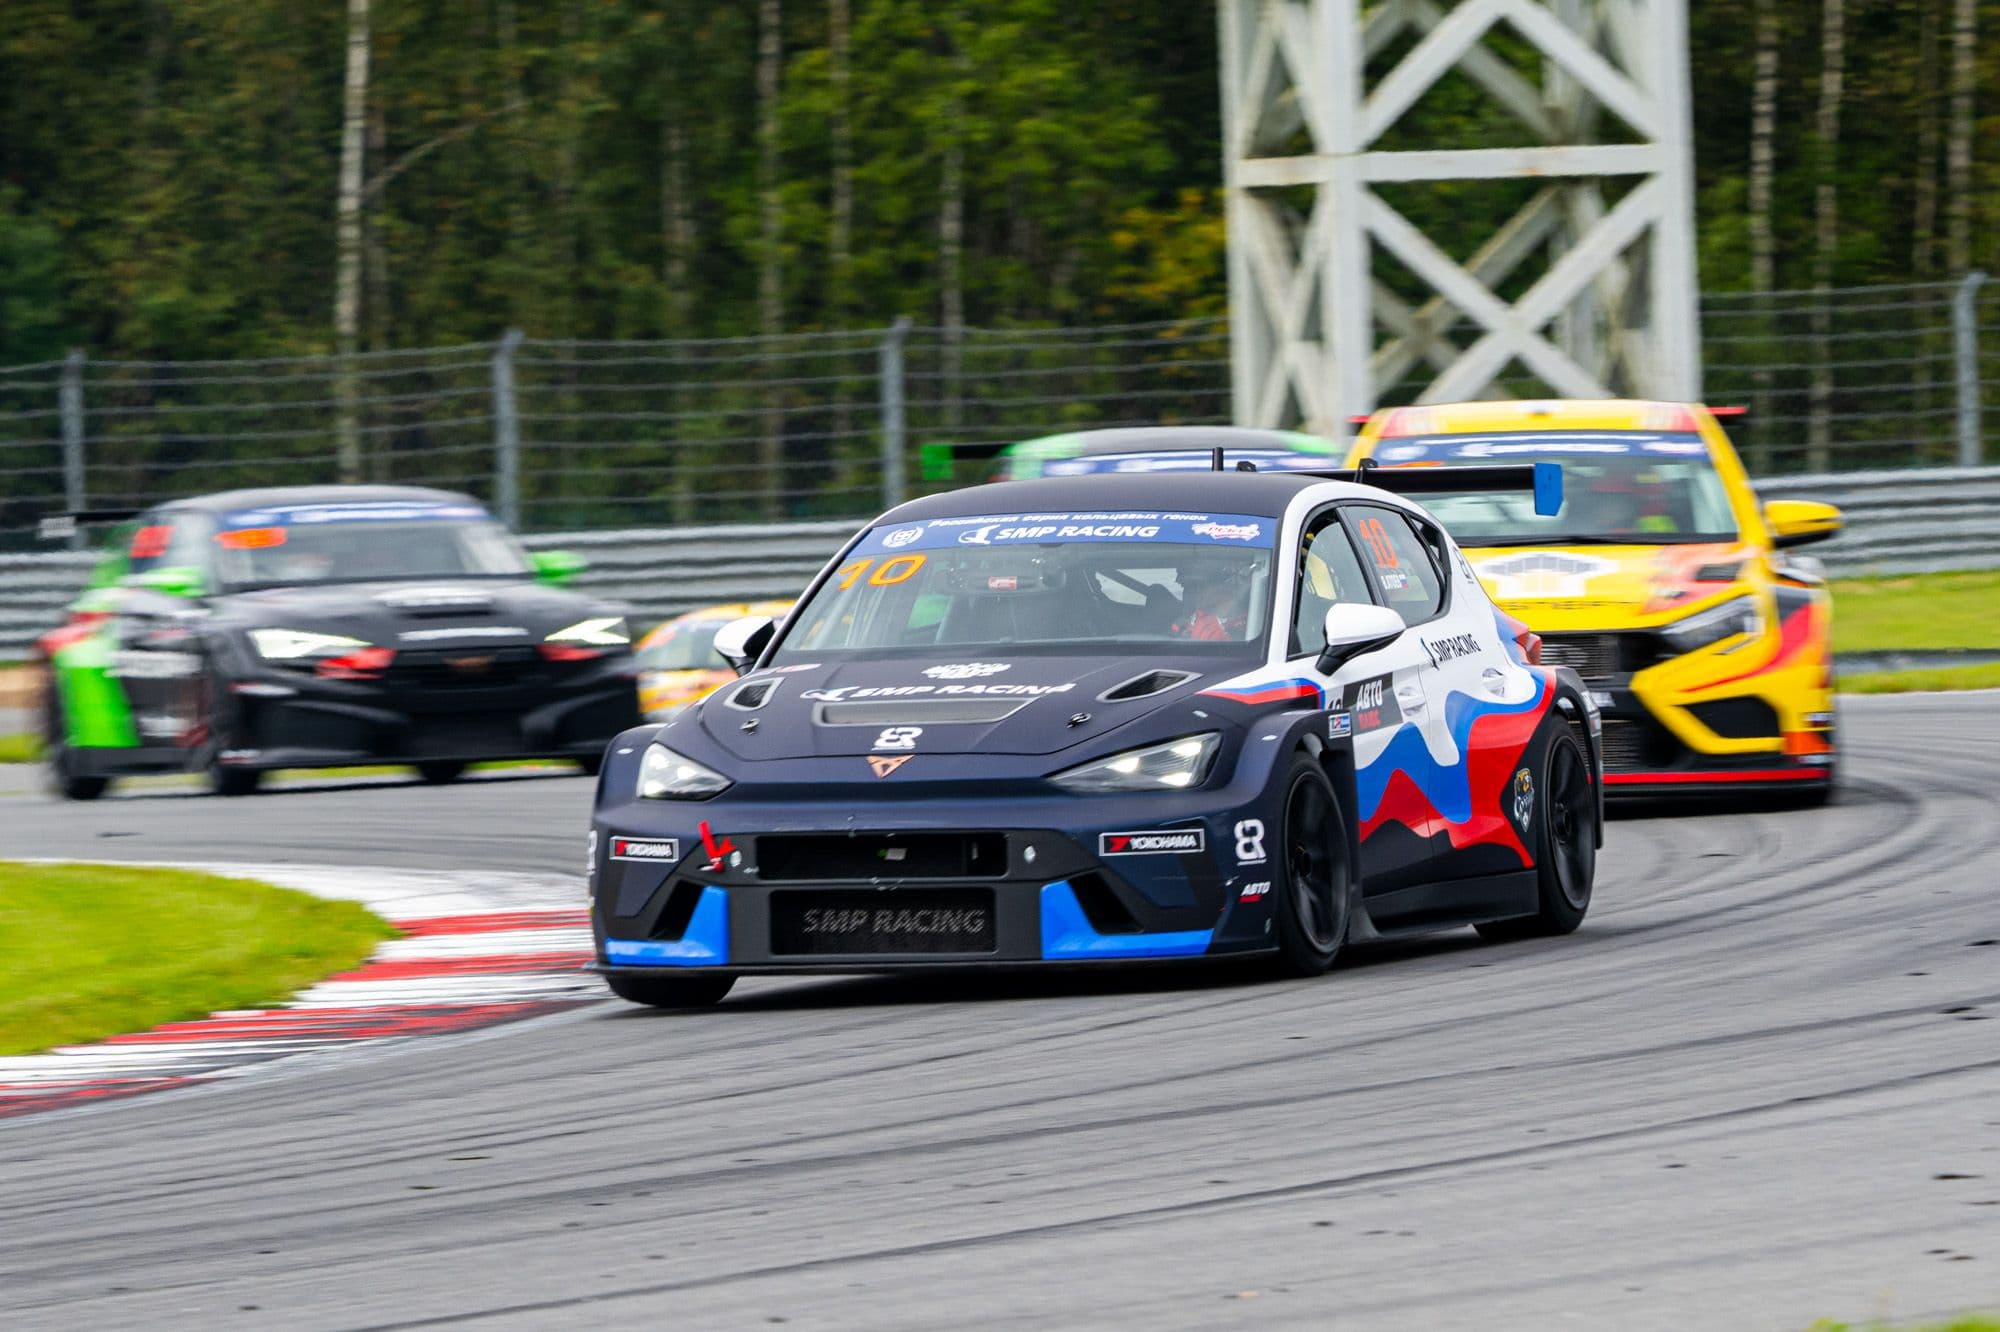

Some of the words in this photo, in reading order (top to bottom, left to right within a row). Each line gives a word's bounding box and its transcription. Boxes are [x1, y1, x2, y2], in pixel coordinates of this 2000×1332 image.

[995, 526, 1057, 540] SMP
[1056, 525, 1160, 538] RACING
[1359, 517, 1399, 570] 10
[837, 553, 928, 592] 10
[1430, 639, 1454, 662] SMP
[1447, 633, 1482, 658] RACING
[850, 686, 936, 698] SMP
[933, 683, 1077, 695] RACING
[1129, 834, 1198, 850] YOKOHAMA
[803, 908, 869, 933] SMP
[871, 908, 986, 933] RACING
